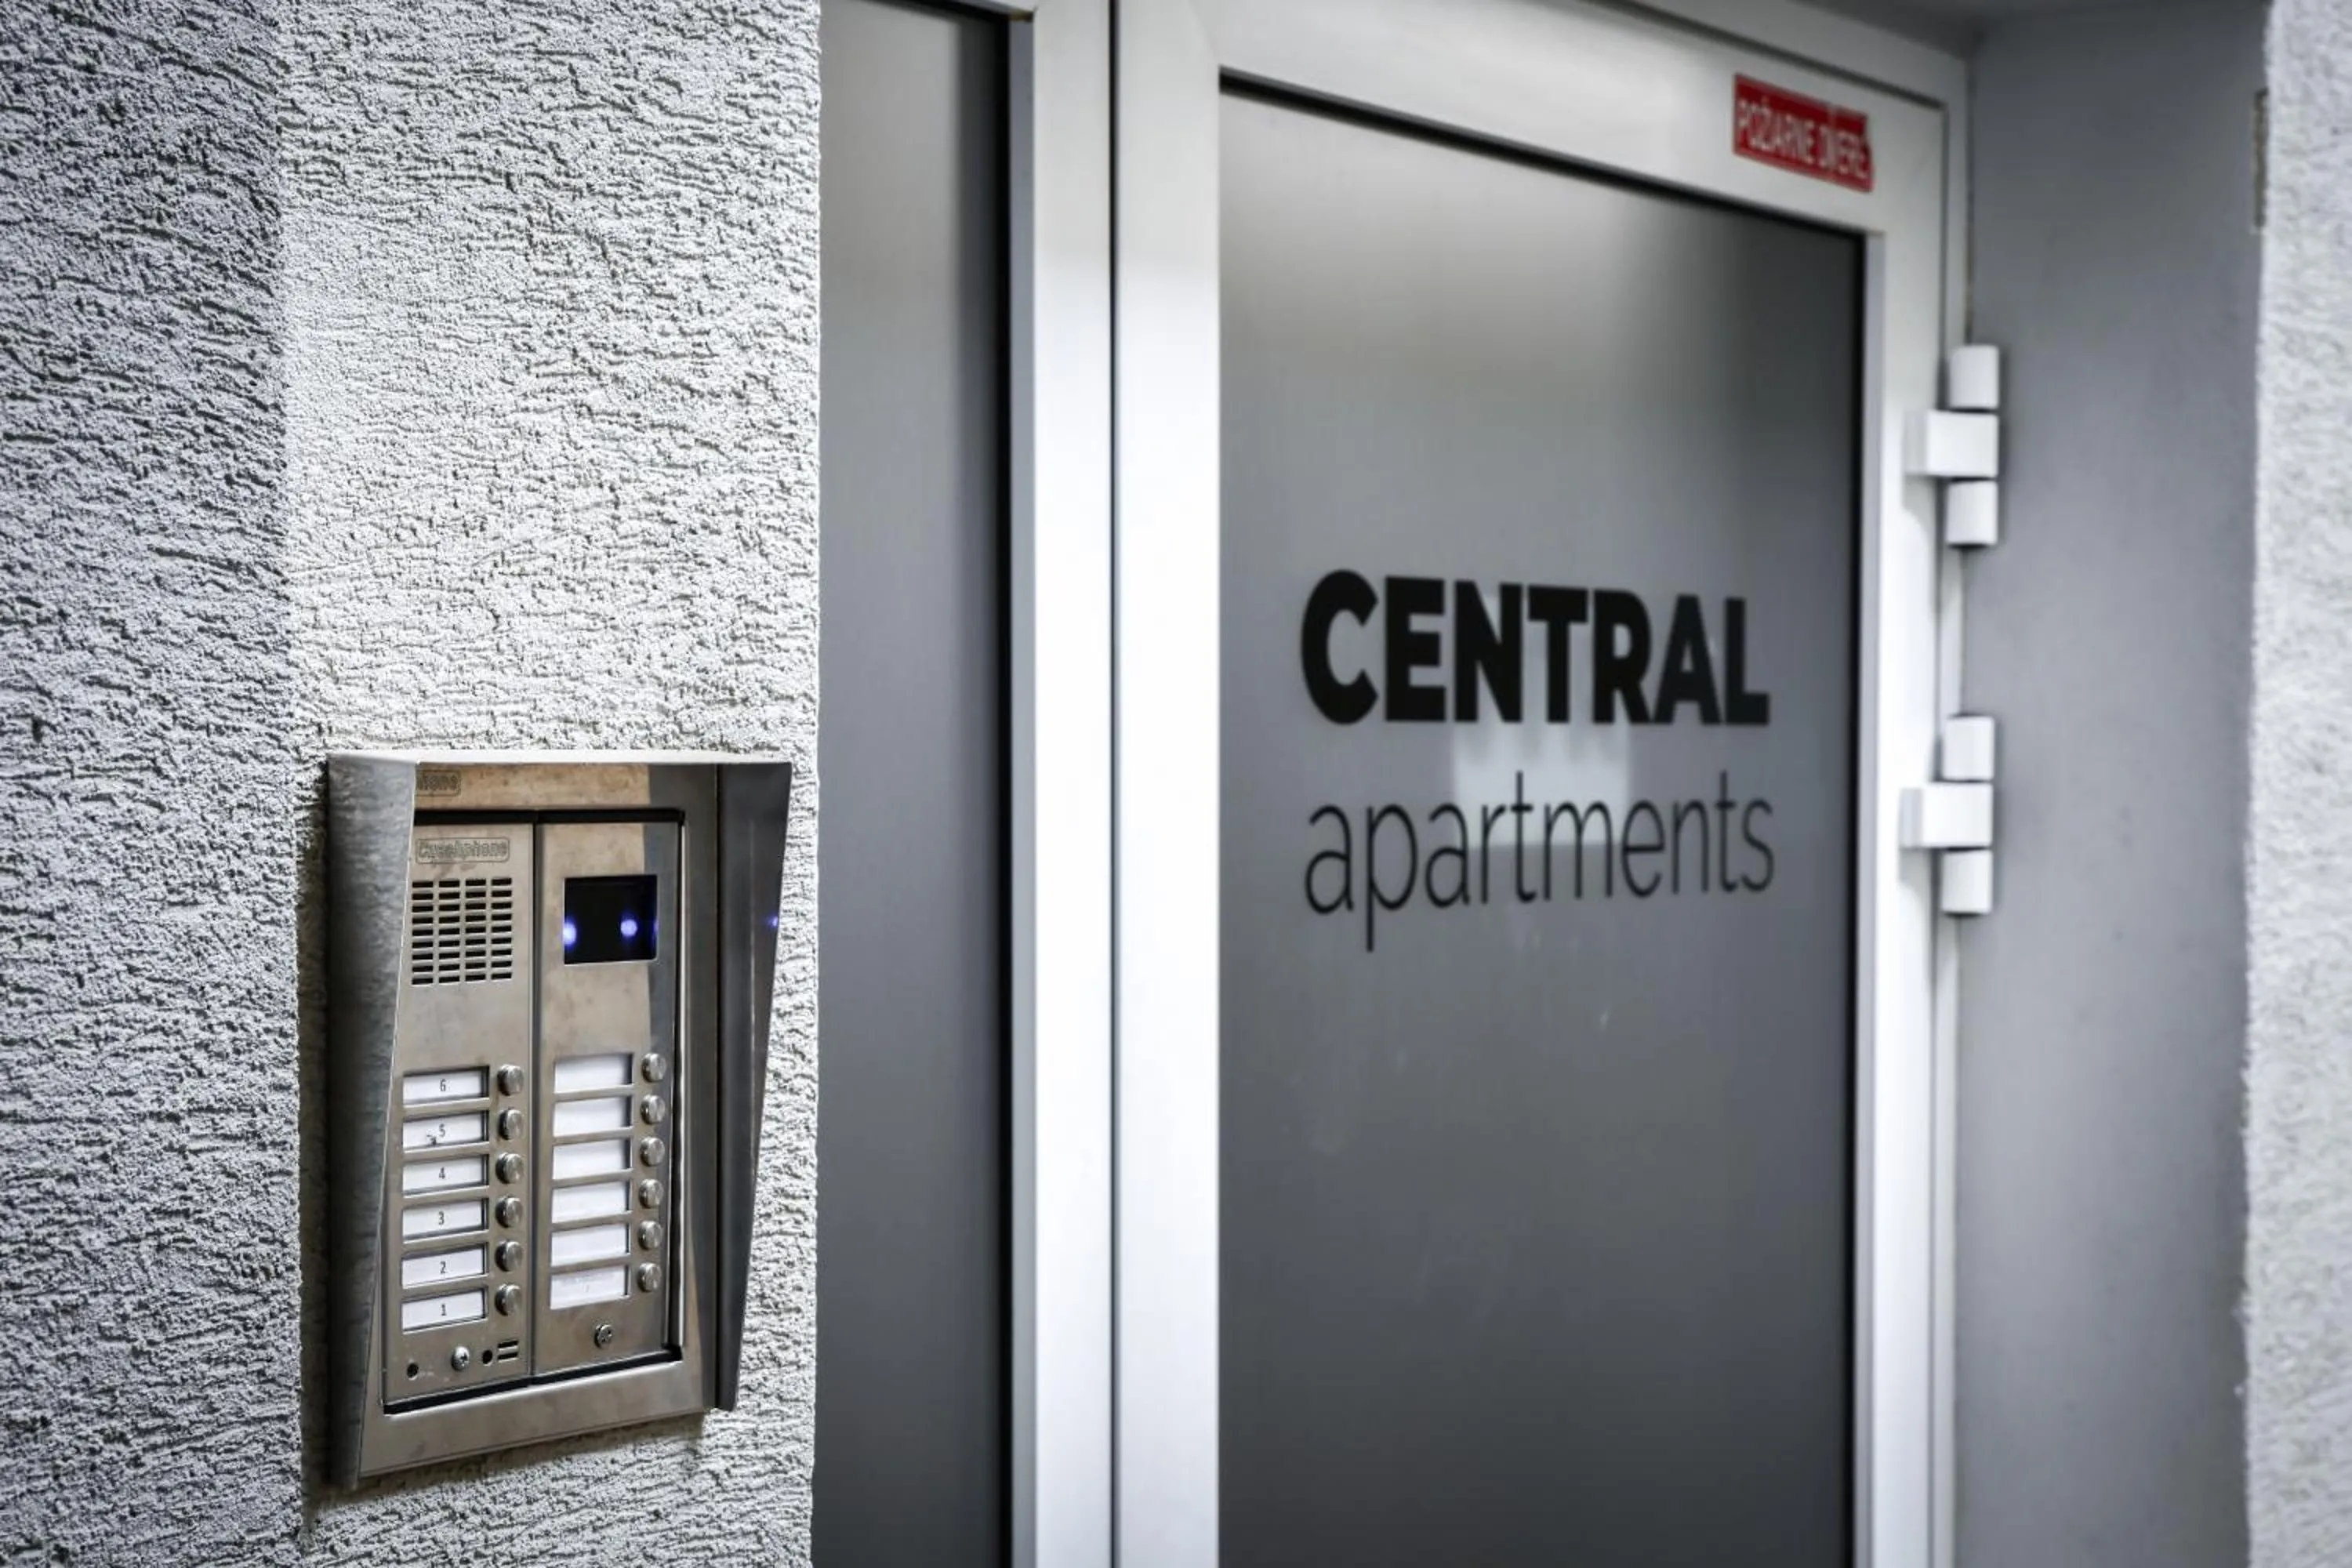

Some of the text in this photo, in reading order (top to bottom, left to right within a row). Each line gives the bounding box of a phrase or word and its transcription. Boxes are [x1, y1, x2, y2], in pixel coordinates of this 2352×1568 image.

[1301, 569, 1770, 725] CENTRAL
[1305, 771, 1774, 952] apartments
[440, 1078, 446, 1091] 6
[439, 1123, 446, 1138] 5
[439, 1167, 445, 1179] 4
[438, 1210, 445, 1225] 3
[440, 1261, 447, 1274] 2
[441, 1304, 447, 1316] 1
